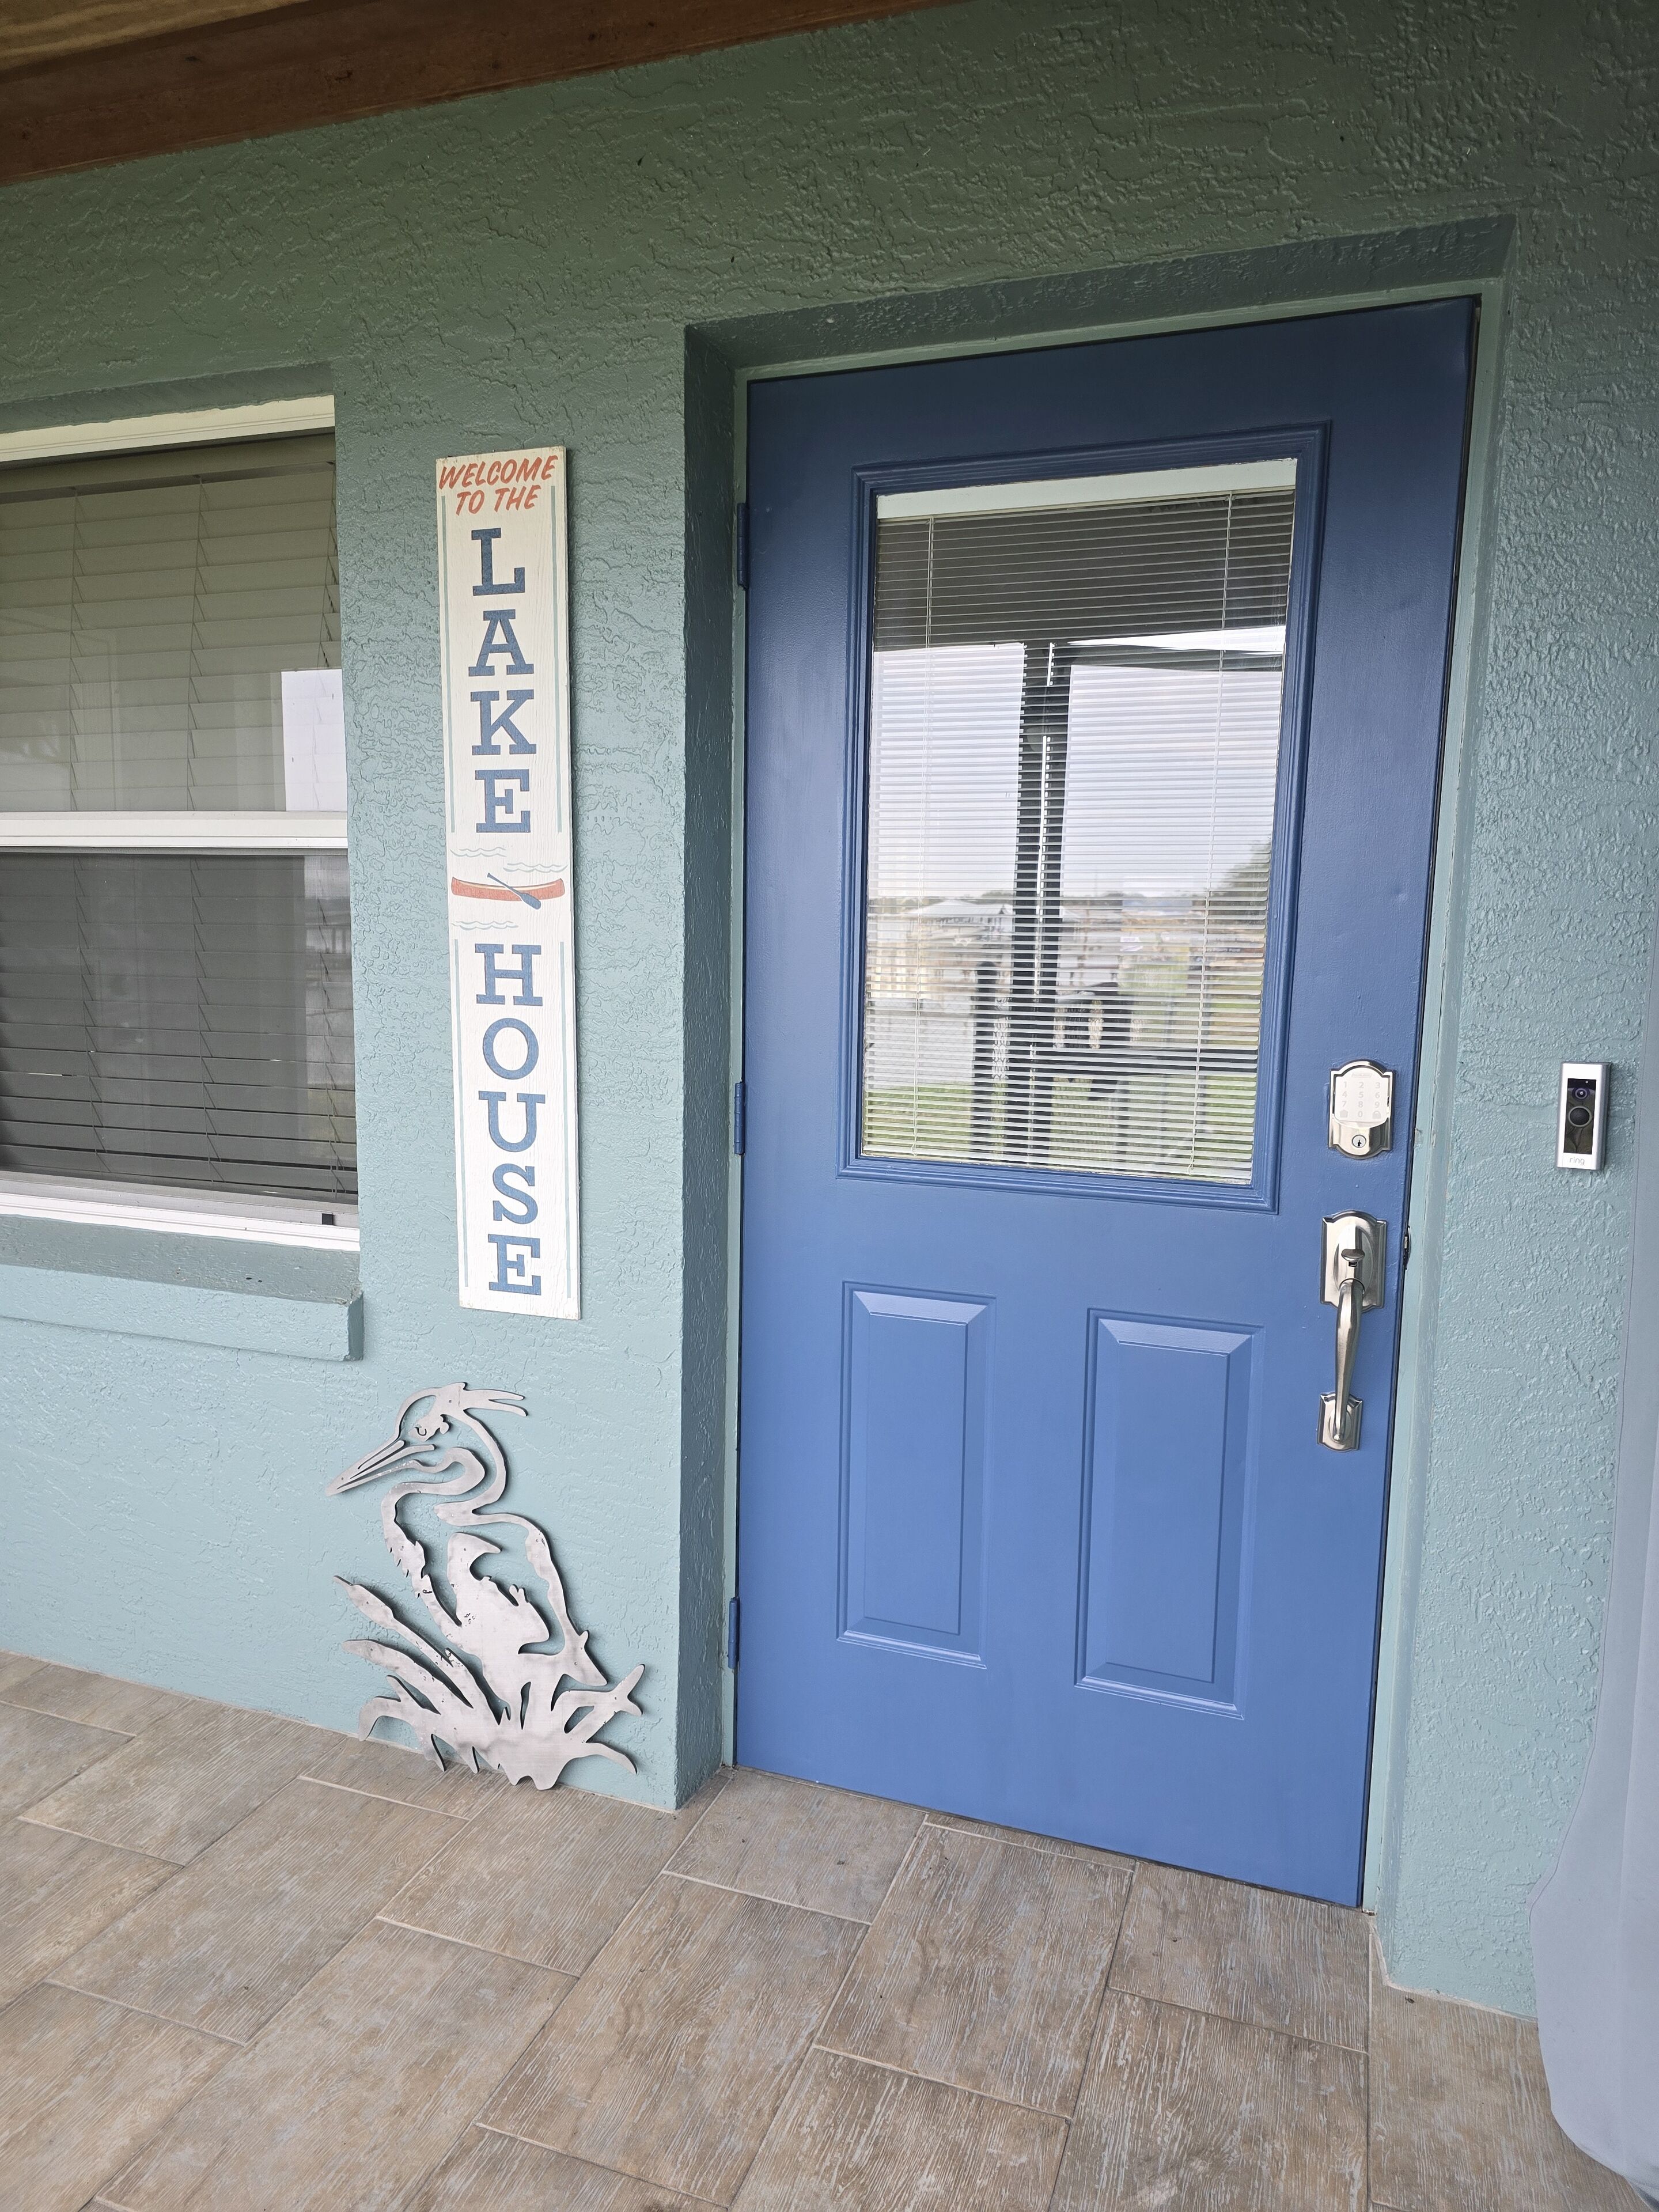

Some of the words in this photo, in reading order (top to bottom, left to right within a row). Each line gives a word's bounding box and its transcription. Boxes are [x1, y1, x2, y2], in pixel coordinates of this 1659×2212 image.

[438, 455, 559, 490] WELCOME
[456, 490, 485, 516] TO
[494, 484, 541, 513] THE
[468, 527, 537, 834] LAKE
[474, 942, 547, 1296] HOUSE
[1569, 1157, 1585, 1166] ring
